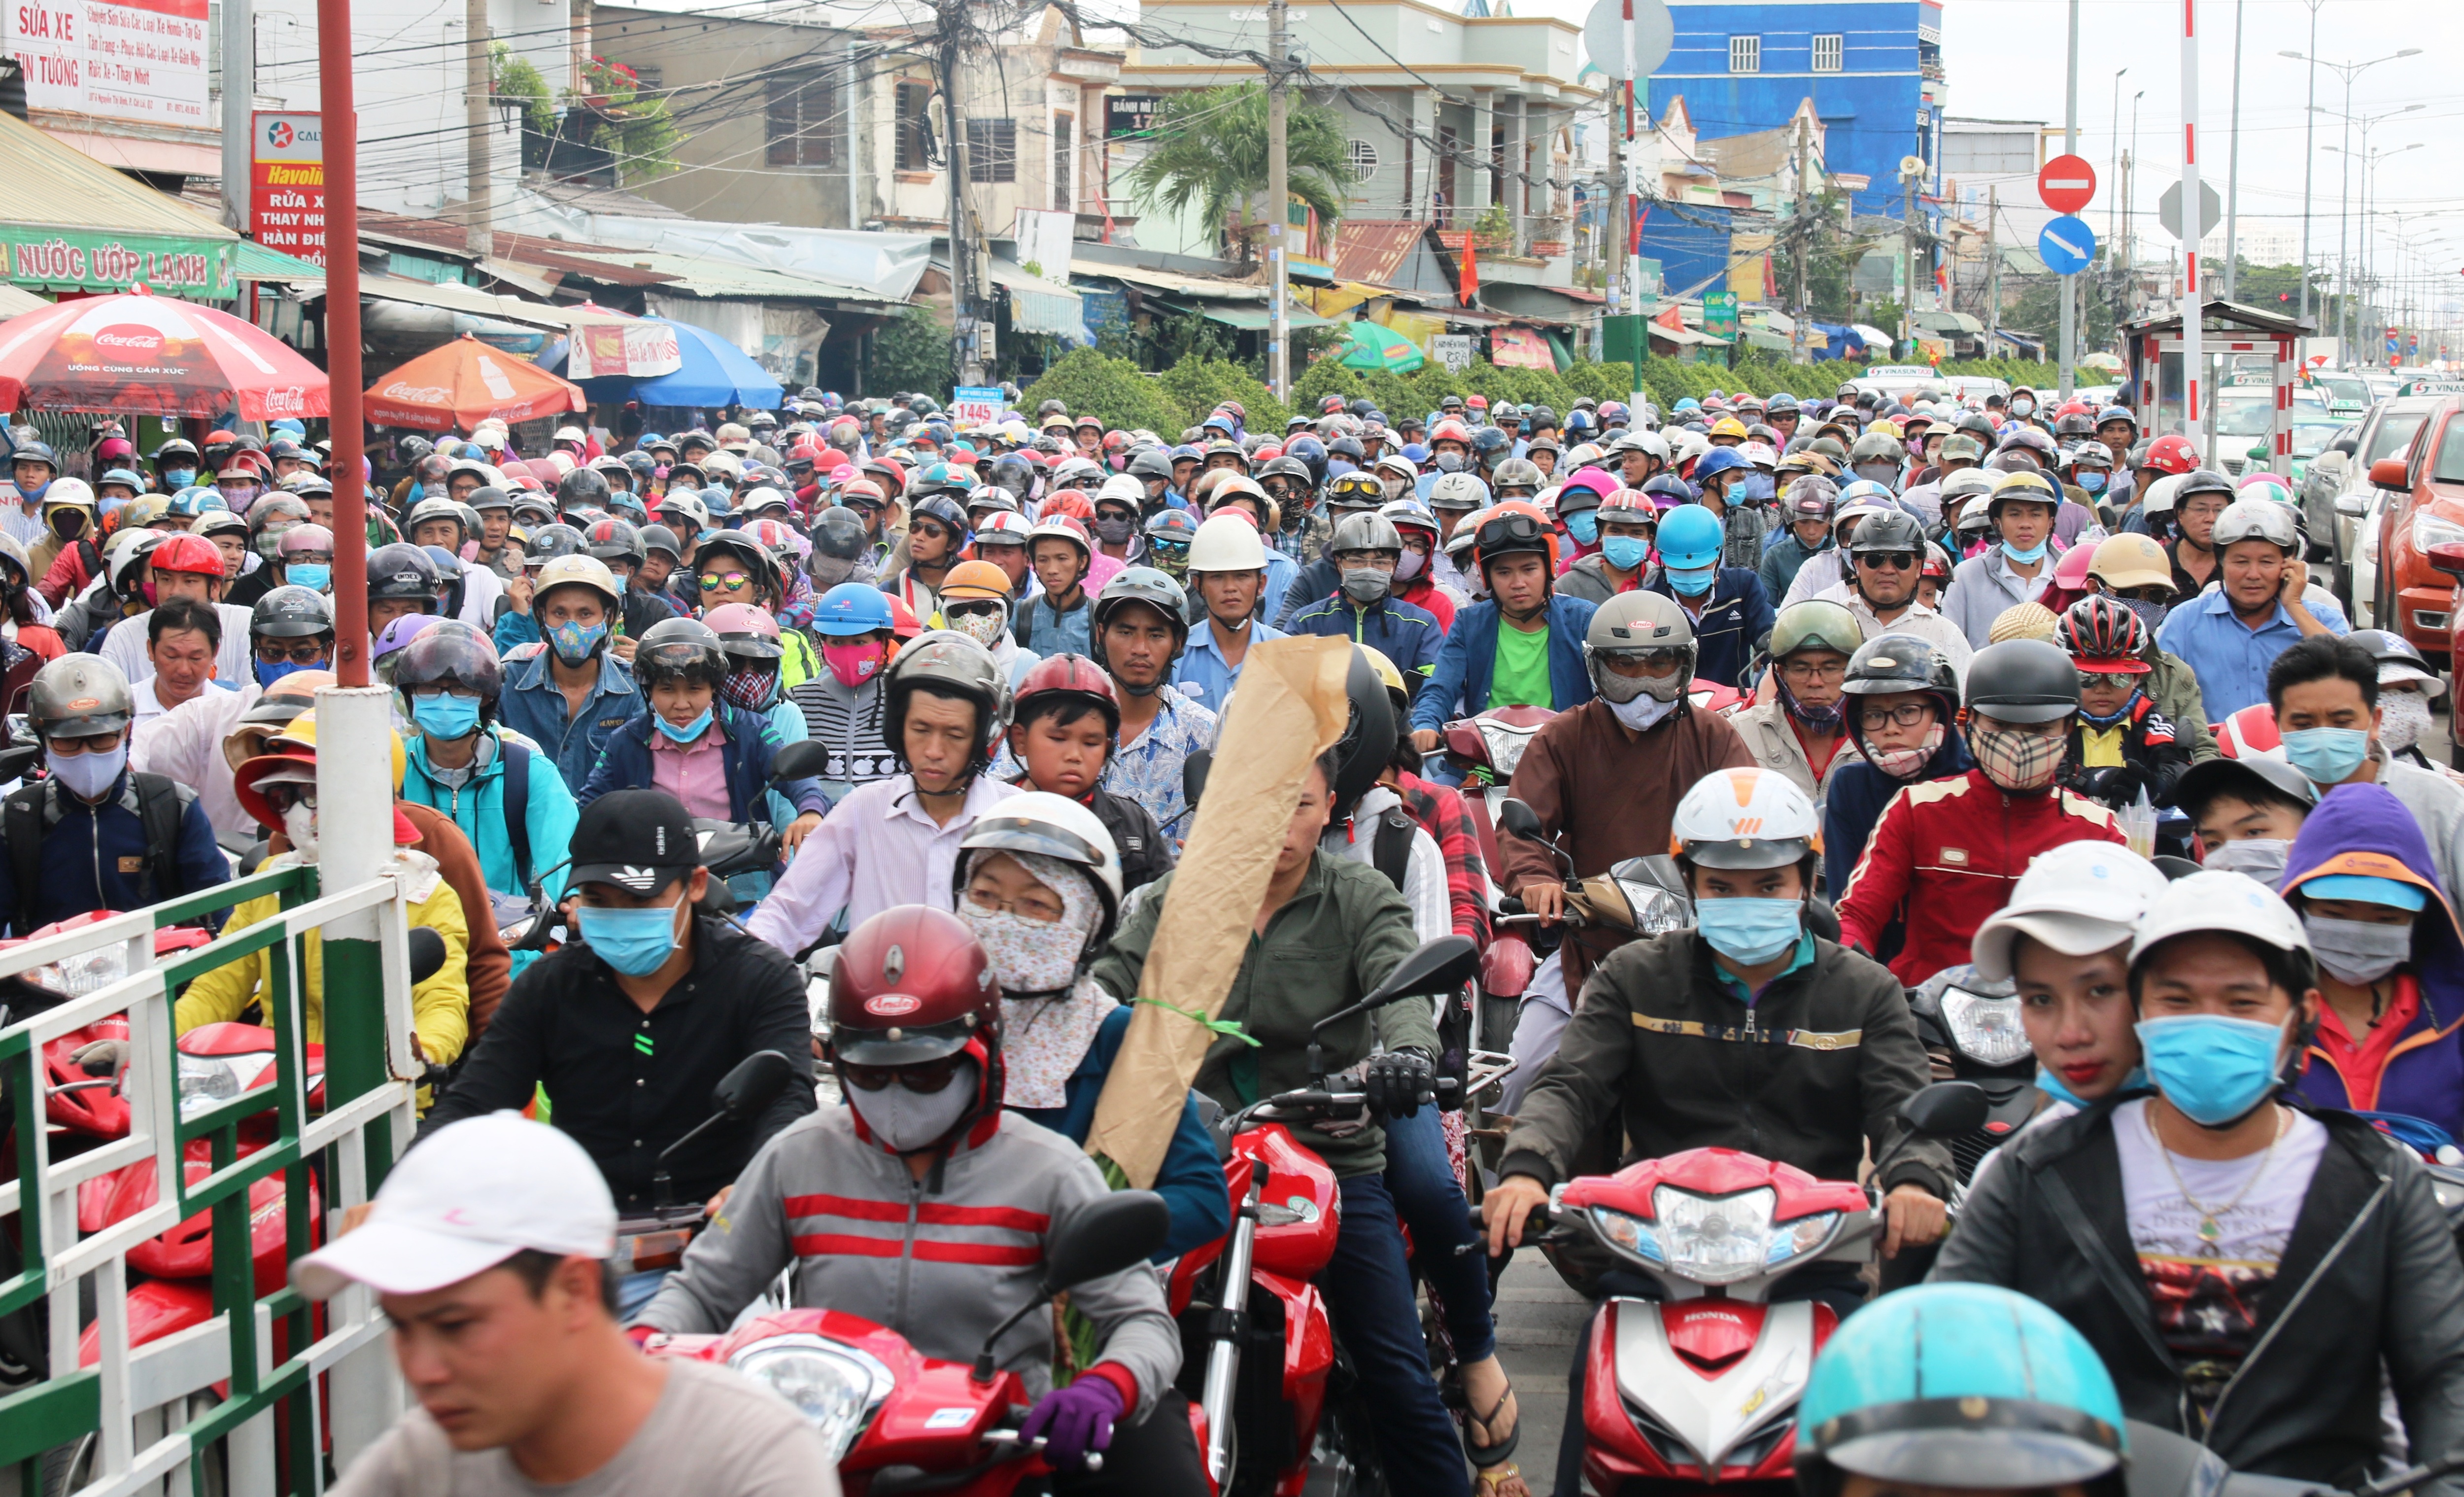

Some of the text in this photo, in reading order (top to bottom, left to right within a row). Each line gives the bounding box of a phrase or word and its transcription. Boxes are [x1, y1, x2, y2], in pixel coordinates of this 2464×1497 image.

[55, 11, 73, 41] XE
[157, 17, 165, 34] Xe
[39, 45, 78, 88] TƯỞNG
[1113, 99, 1137, 112] BÁNH
[1140, 99, 1151, 113] MÌ
[270, 190, 307, 208] RỬA
[261, 212, 300, 226] THAY
[263, 229, 297, 245] HÀN
[16, 238, 86, 281] NƯỚC
[91, 242, 141, 282] ƯỚP
[147, 253, 207, 289] LẠNH
[959, 403, 991, 420] 1445
[657, 826, 665, 855] adidas
[1684, 1311, 1743, 1325] HONDA
